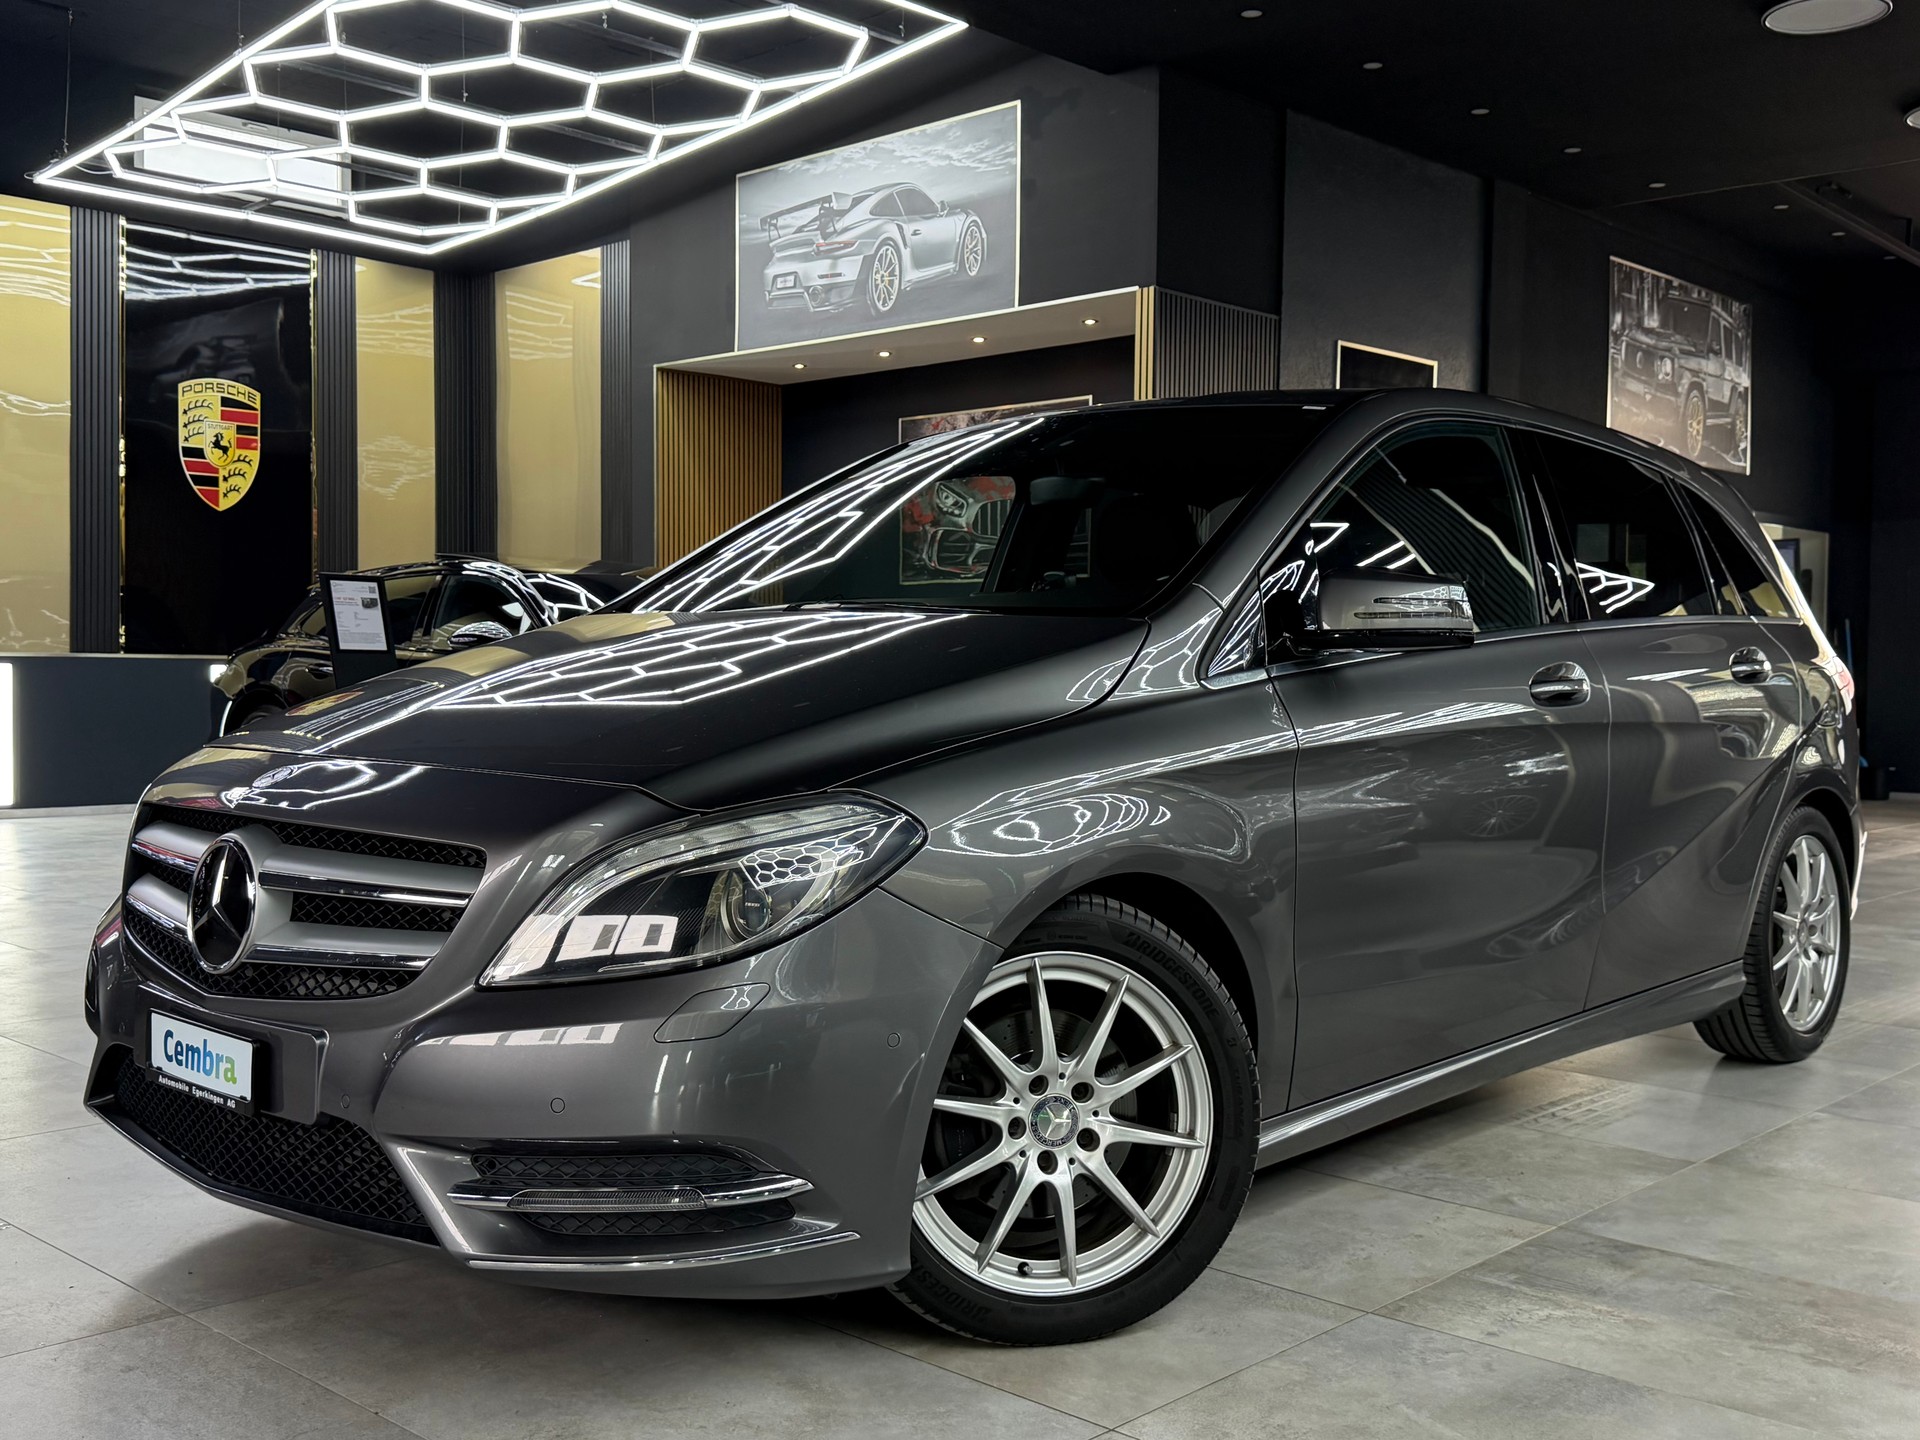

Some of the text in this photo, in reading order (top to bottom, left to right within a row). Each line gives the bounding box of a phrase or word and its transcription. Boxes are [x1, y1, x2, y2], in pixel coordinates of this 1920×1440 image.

[181, 382, 257, 405] PORSCHE
[1123, 932, 1220, 1018] BRIDGESTONE
[163, 1029, 237, 1085] Cembra
[158, 1074, 236, 1109] Automobile Egerkingen AG
